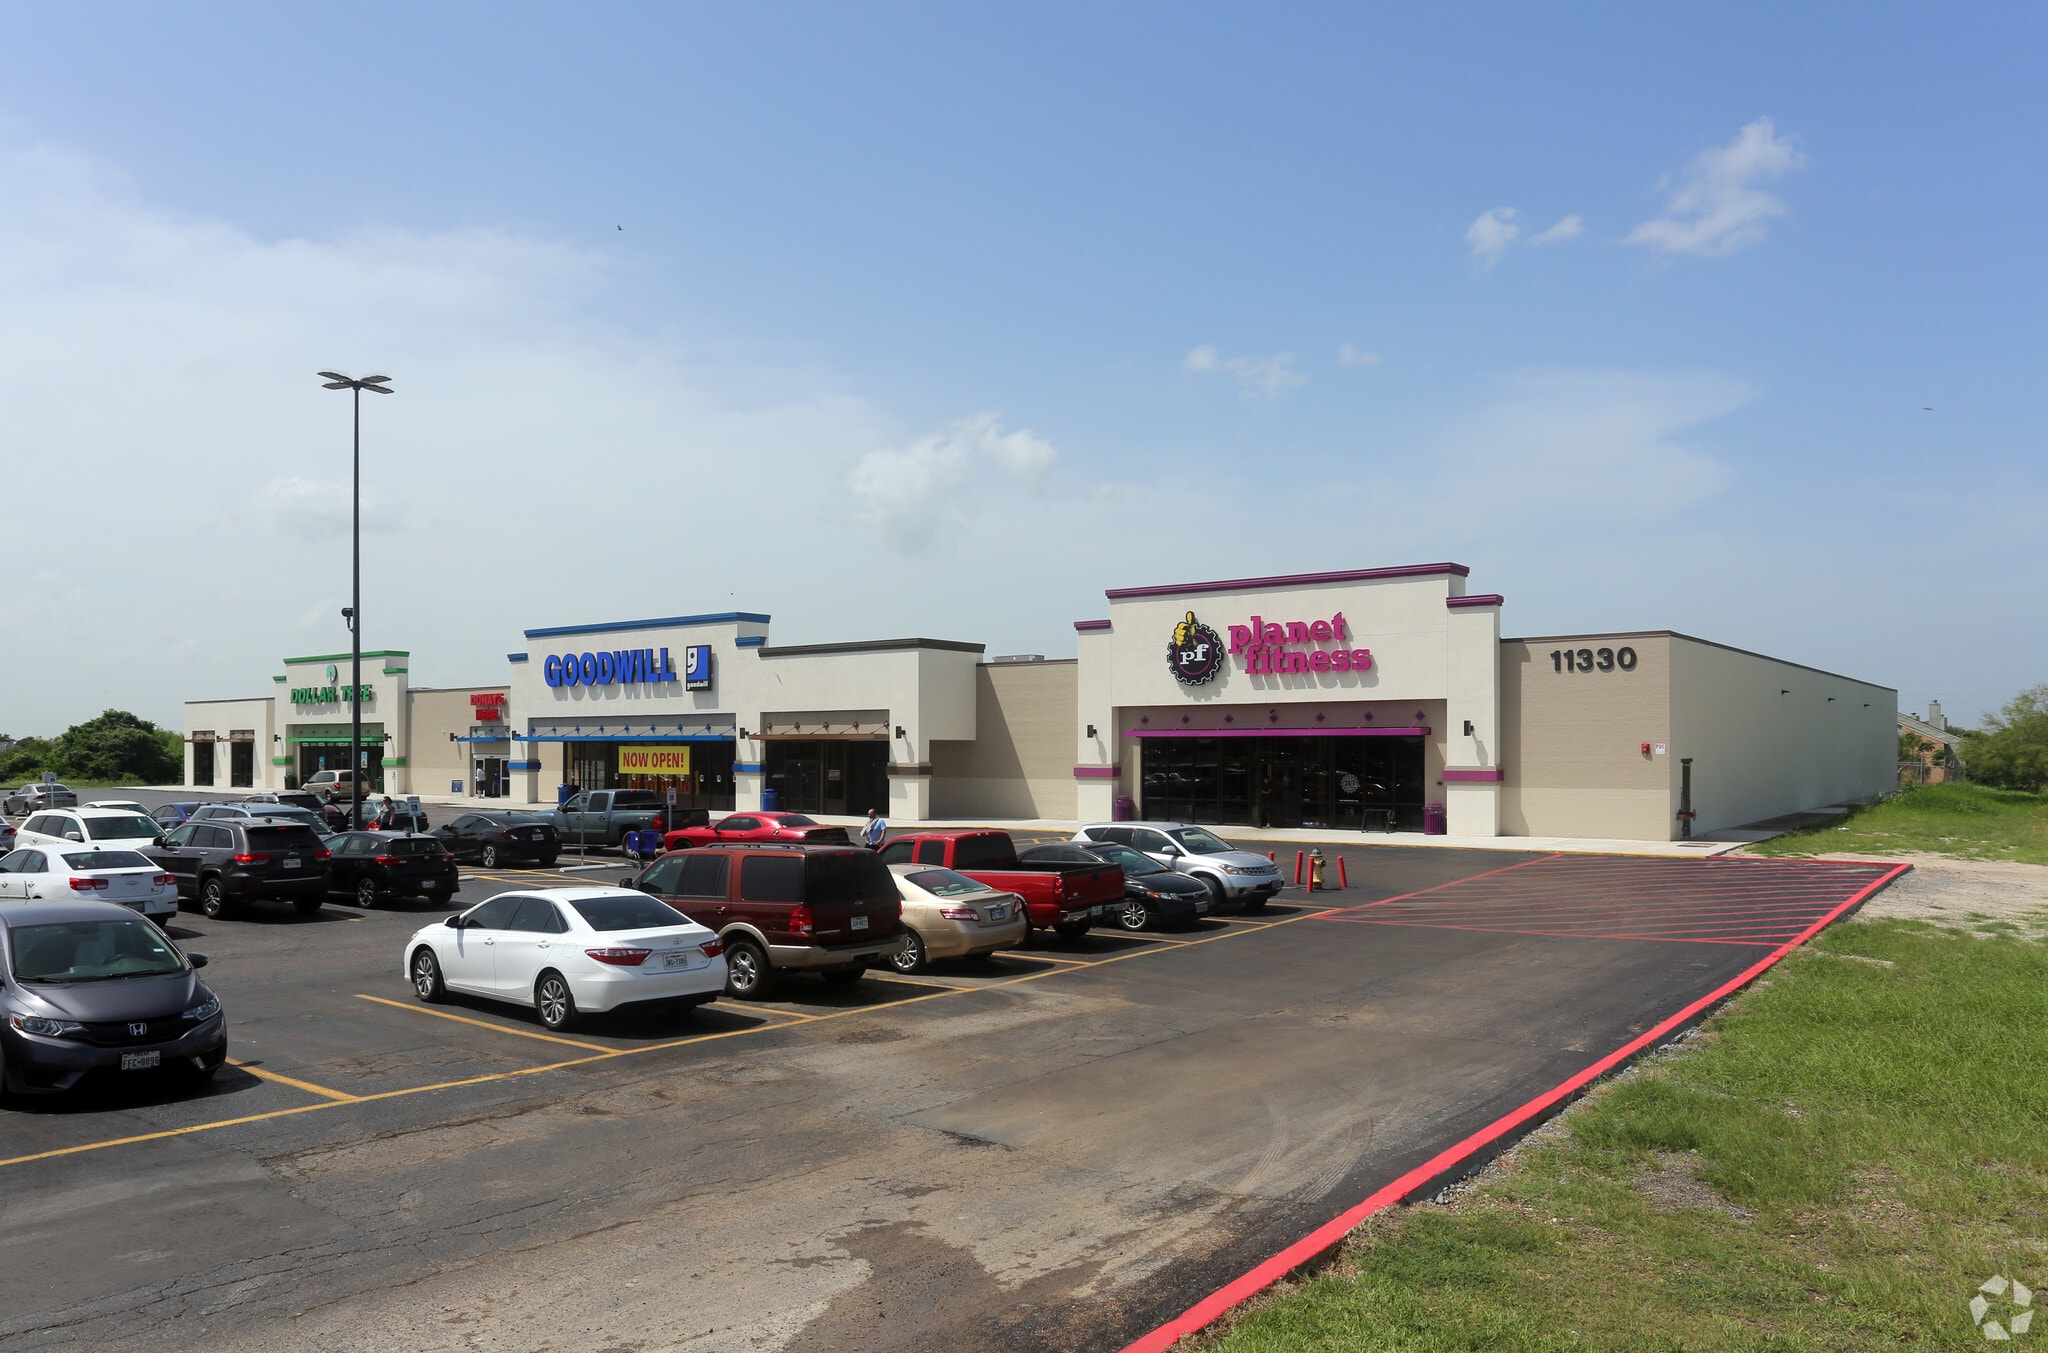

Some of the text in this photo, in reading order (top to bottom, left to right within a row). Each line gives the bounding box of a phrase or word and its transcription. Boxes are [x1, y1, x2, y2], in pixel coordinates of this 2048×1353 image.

[1228, 612, 1346, 654] planet
[1180, 643, 1209, 665] pf
[1245, 644, 1371, 674] fitness
[1550, 646, 1637, 672] 11330
[544, 647, 677, 688] GOODWILL
[291, 684, 372, 704] DOLLAR TRE
[687, 680, 708, 690] goodwill
[470, 693, 505, 706] DONATE
[476, 708, 499, 721] HERE
[623, 752, 684, 768] NOW OPEN!
